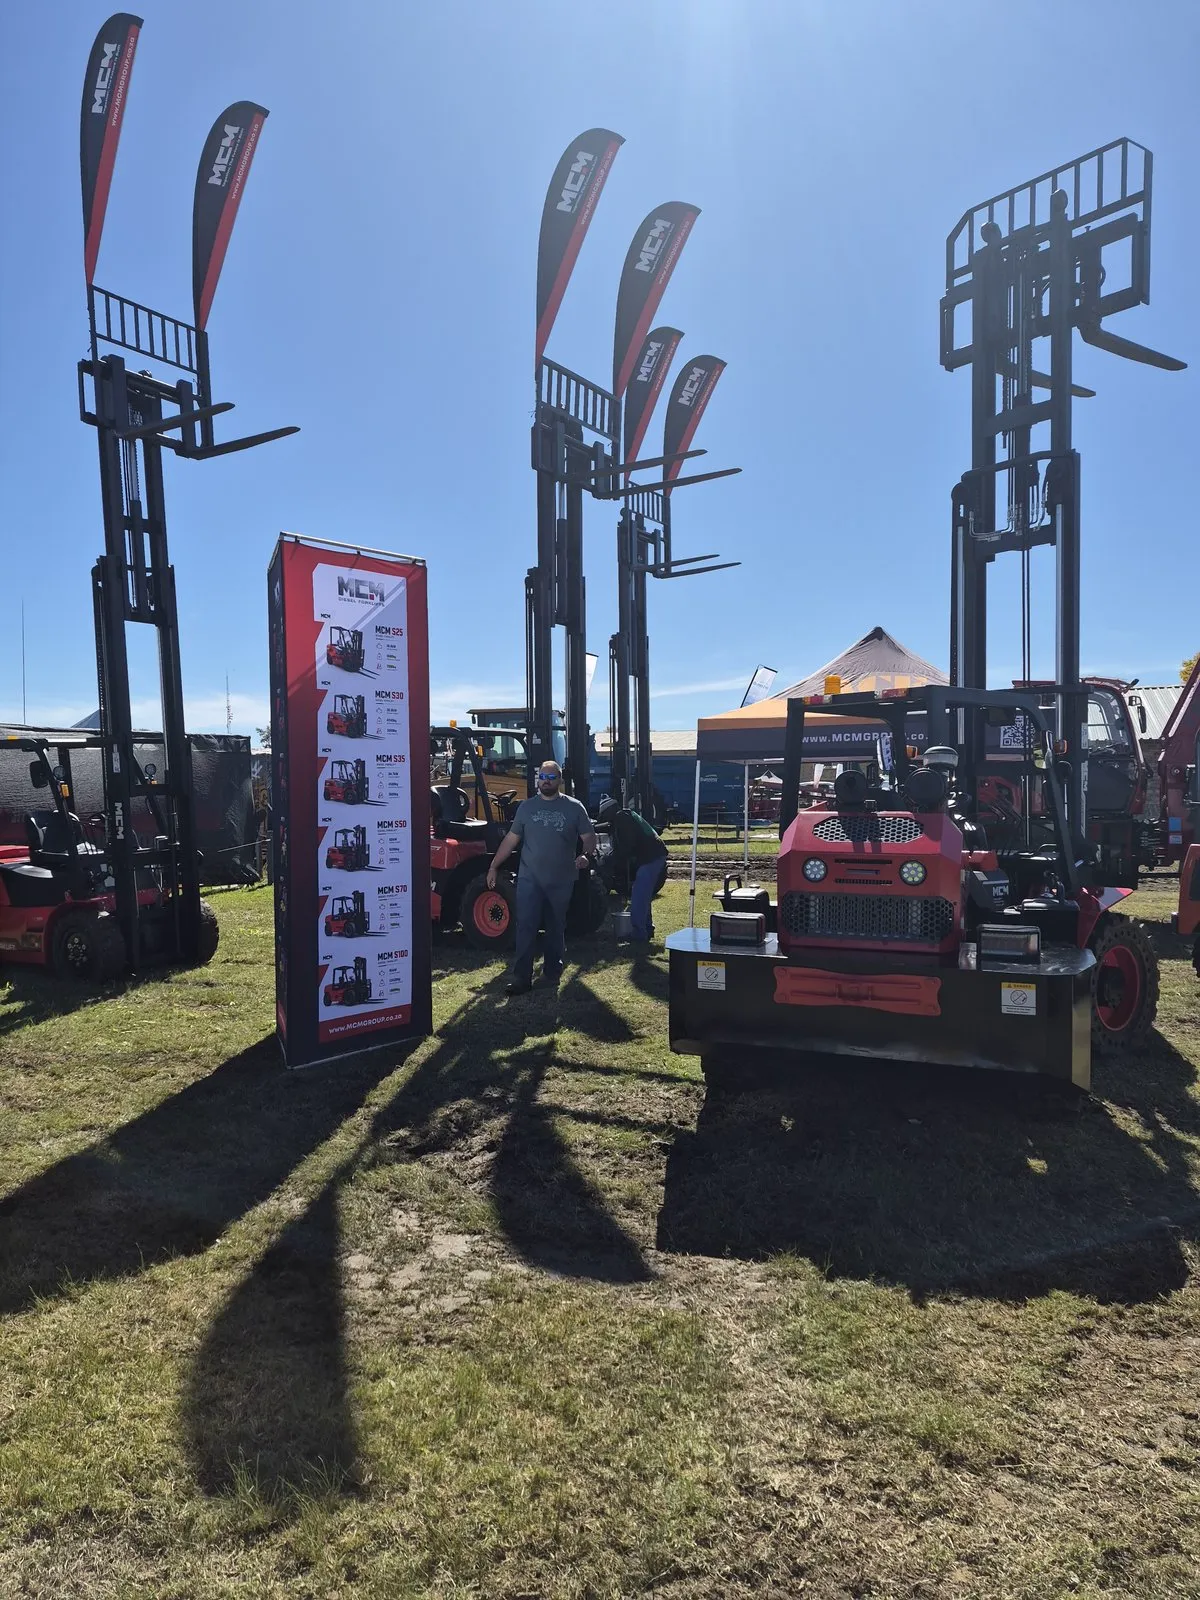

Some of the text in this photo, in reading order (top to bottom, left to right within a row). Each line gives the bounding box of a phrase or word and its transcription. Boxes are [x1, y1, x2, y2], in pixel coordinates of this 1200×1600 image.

[91, 42, 117, 114] MCM
[207, 124, 240, 186] MCM
[556, 150, 595, 213] MCM
[634, 218, 671, 273] MCM
[637, 341, 662, 382] MCM
[678, 366, 704, 407] MCM
[337, 575, 385, 602] MCM
[375, 625, 404, 637] MCM S25
[375, 690, 404, 700] MCM S30
[376, 754, 406, 763] MCM S35
[114, 802, 125, 840] MCM
[377, 820, 407, 829] MCM S50
[377, 884, 408, 895] MCM S70
[992, 885, 1009, 896] MCM
[377, 949, 409, 961] MCM S100
[328, 1014, 403, 1034] www.MCMGROUP.co.za
